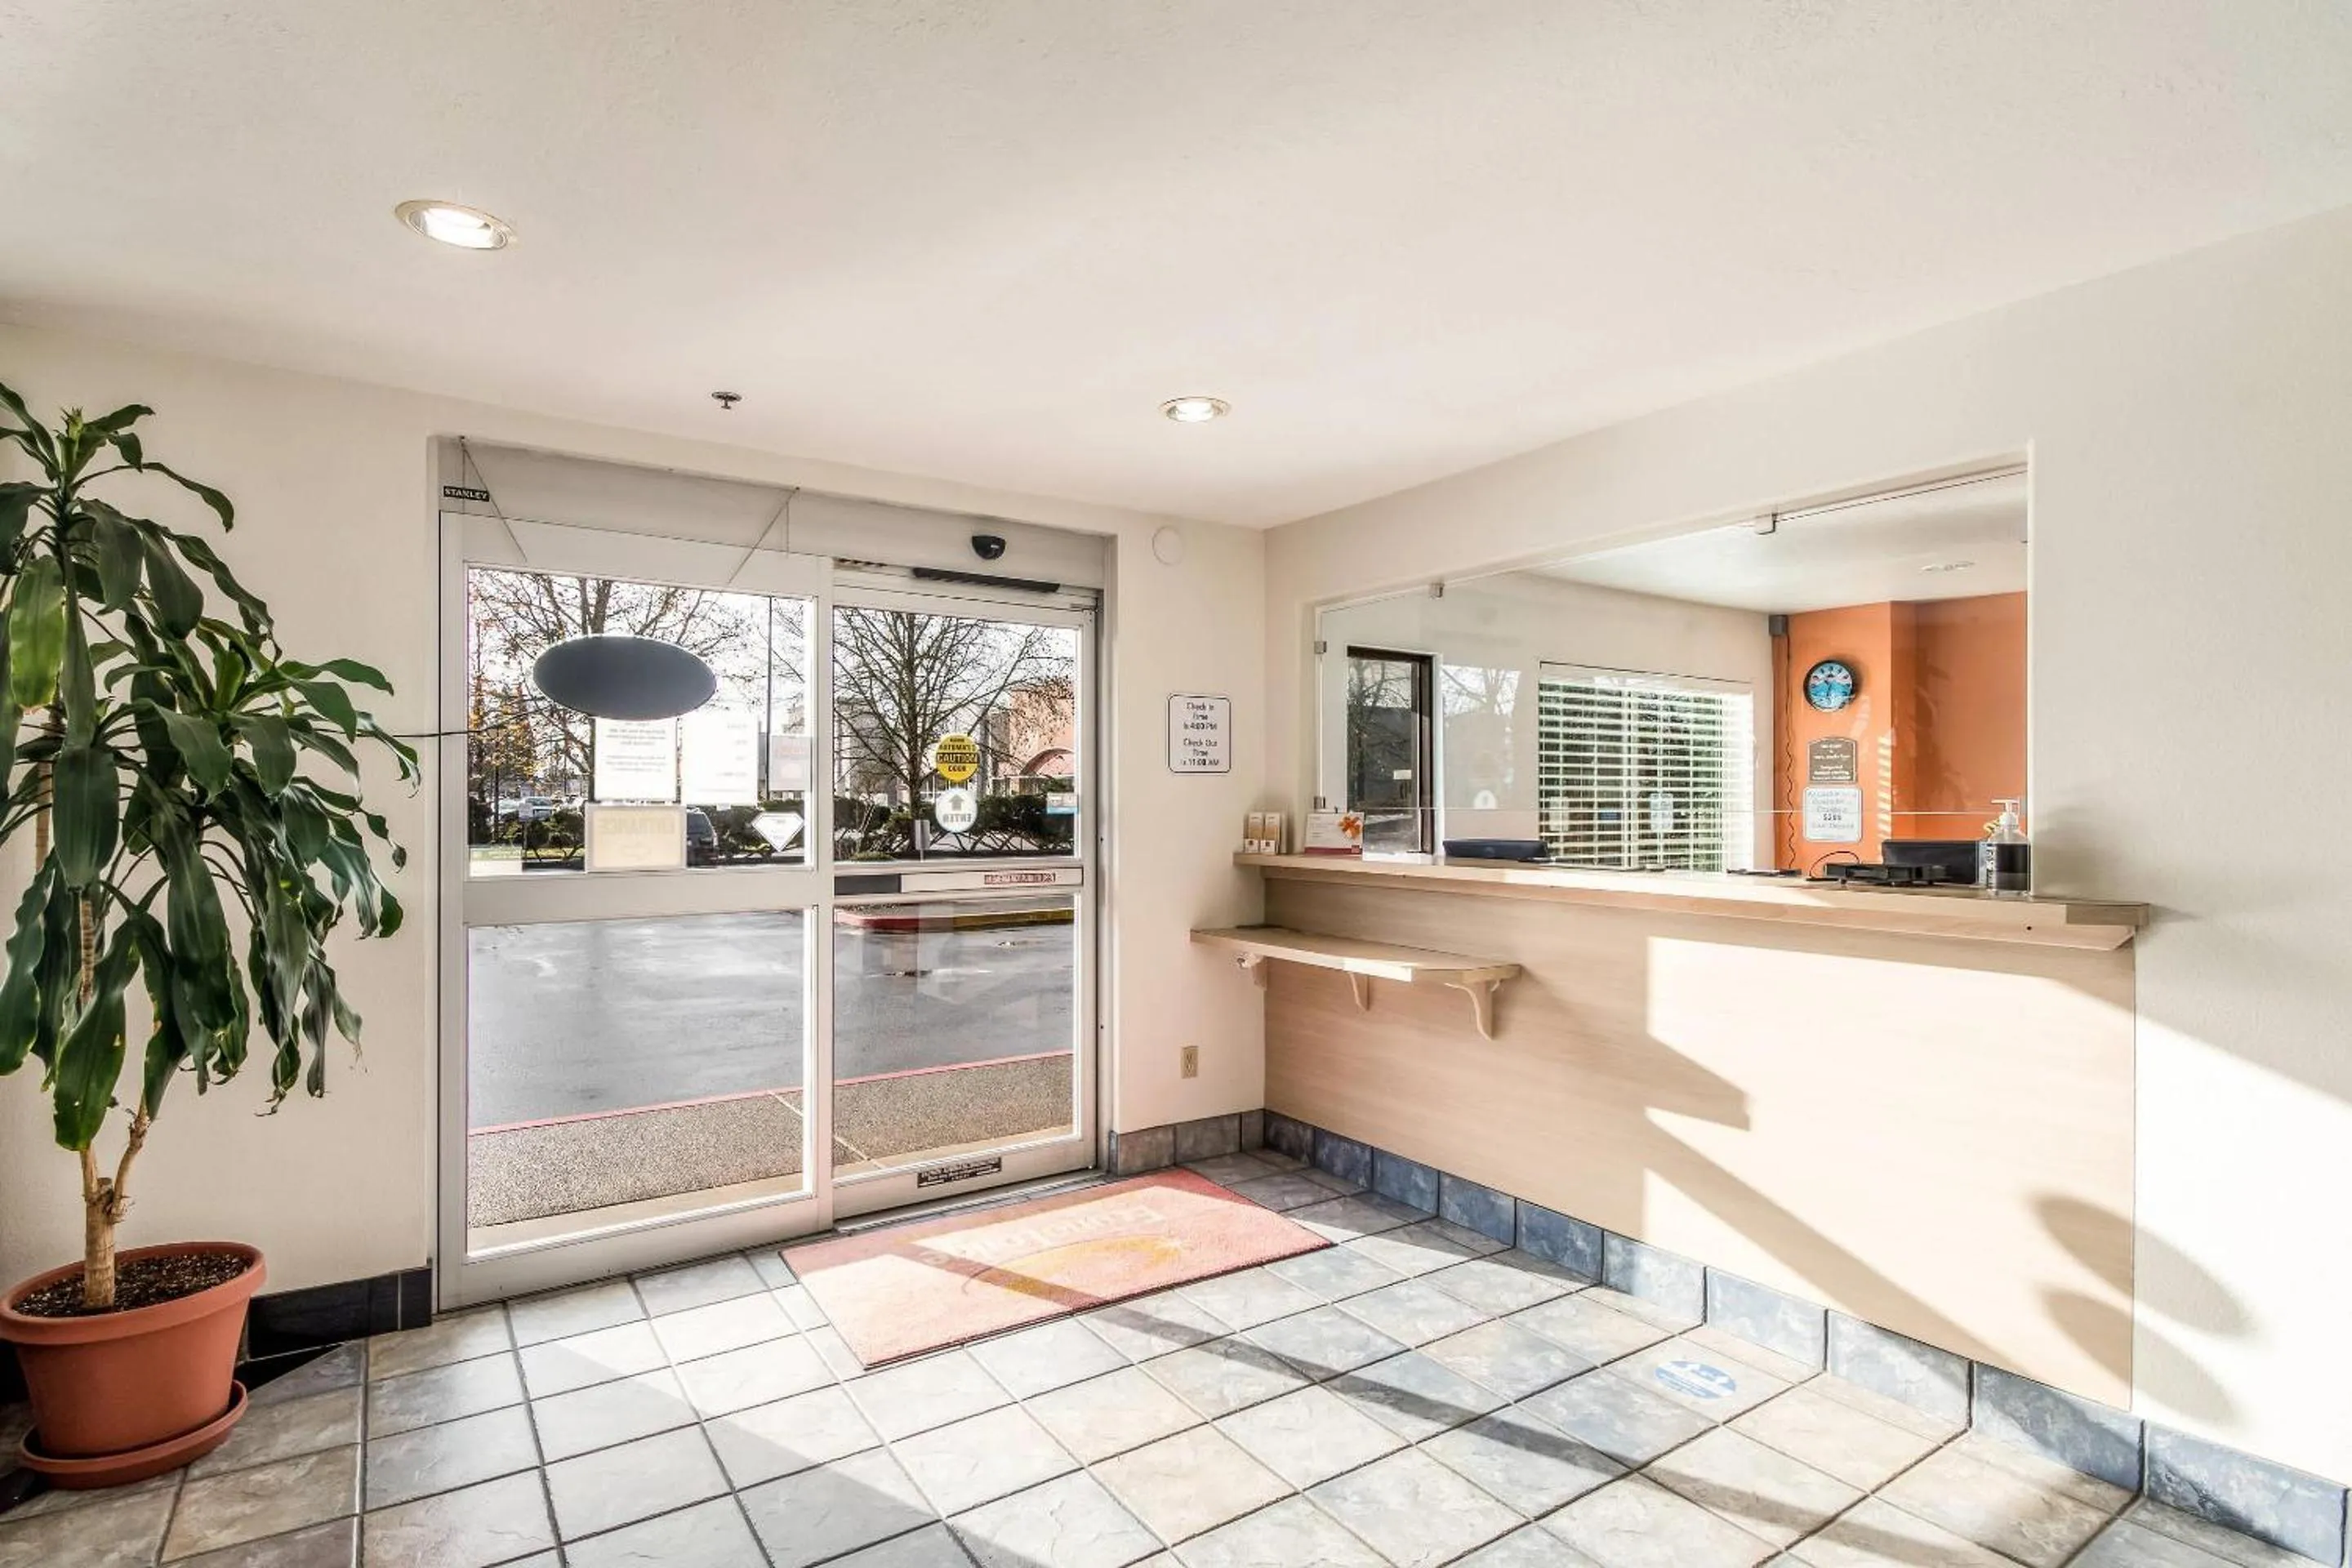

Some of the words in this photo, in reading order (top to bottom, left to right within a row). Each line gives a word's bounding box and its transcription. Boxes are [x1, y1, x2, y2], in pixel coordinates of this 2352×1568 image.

[444, 488, 488, 500] STANLEY
[1186, 702, 1207, 710] Check
[1183, 737, 1204, 746] Check
[938, 753, 978, 763] CAUTION
